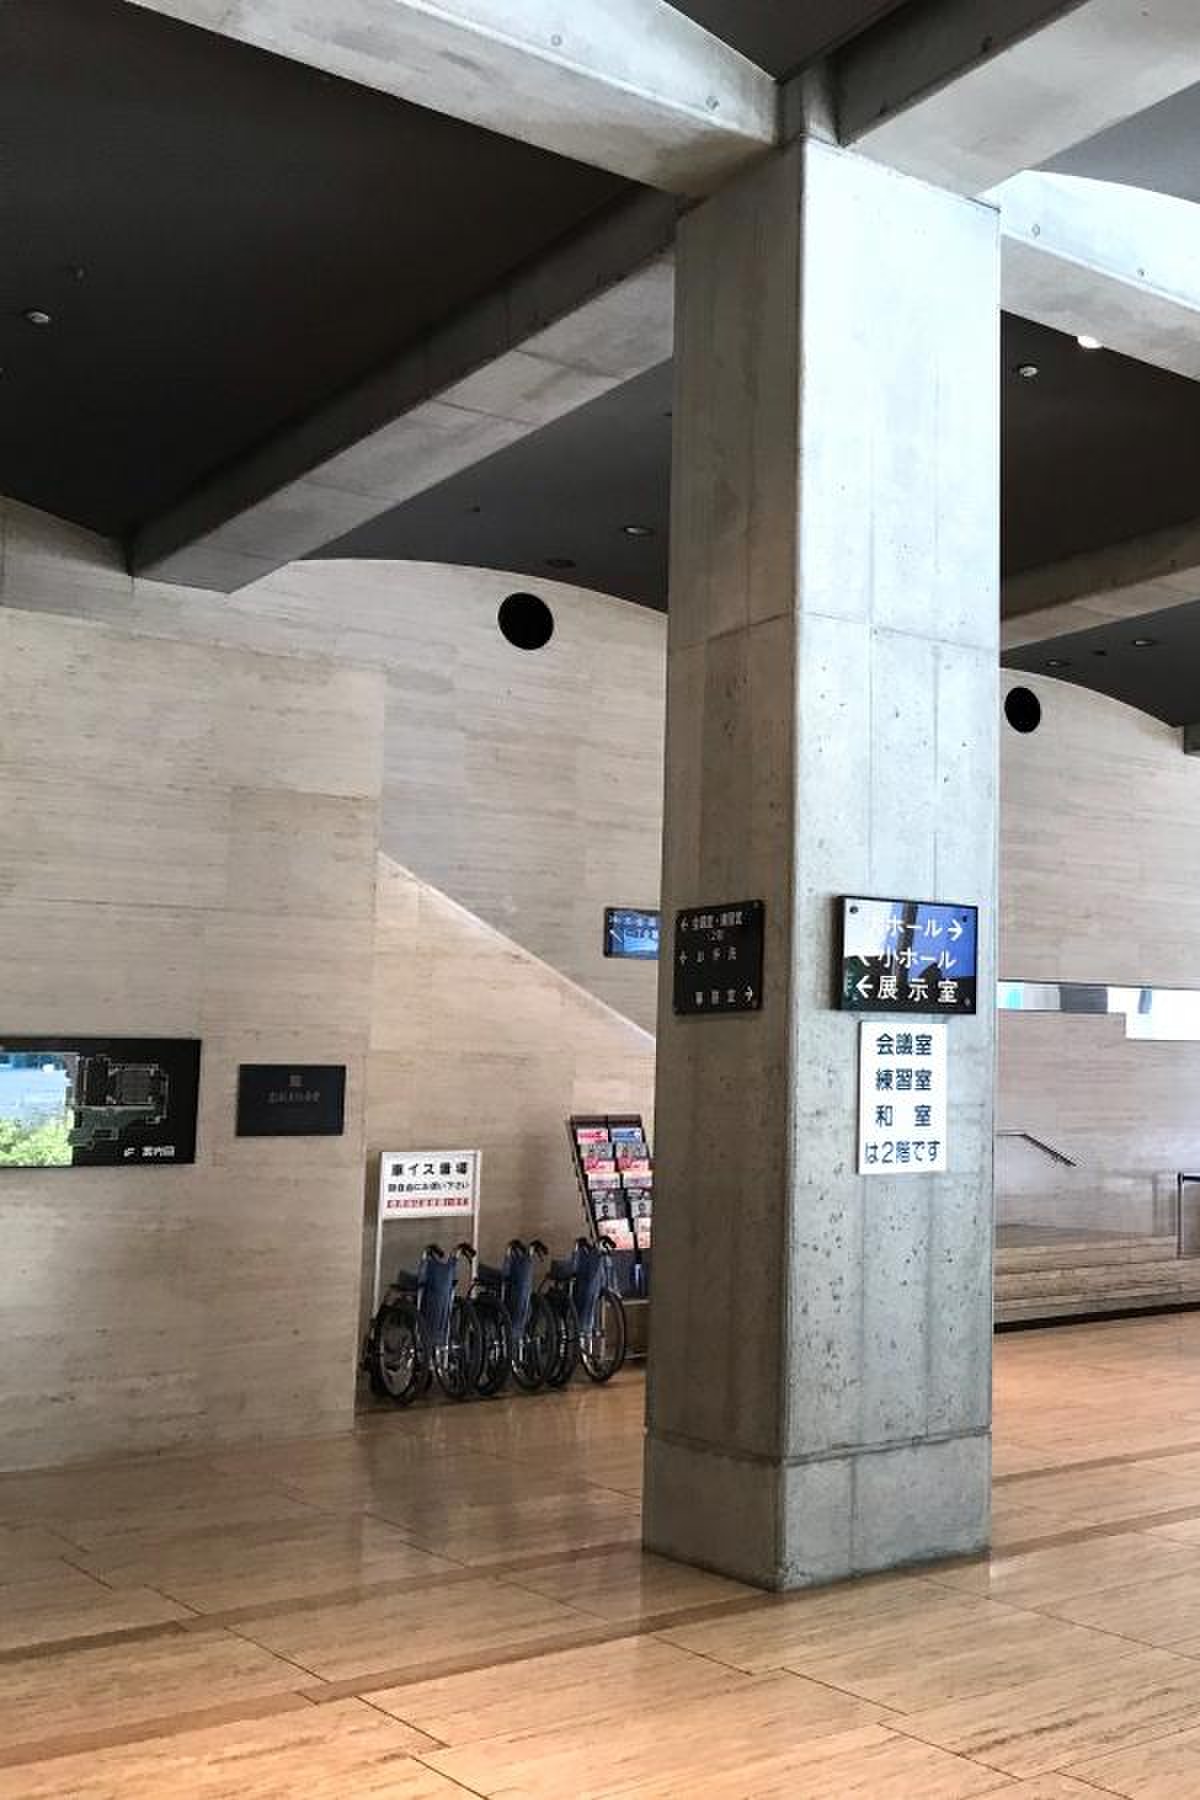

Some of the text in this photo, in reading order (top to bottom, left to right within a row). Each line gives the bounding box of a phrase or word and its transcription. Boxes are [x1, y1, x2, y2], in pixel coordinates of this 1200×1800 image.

[883, 915, 943, 938] ホール
[878, 947, 957, 969] 小ホール
[877, 975, 958, 1004] 展示室
[876, 1033, 933, 1056] 会議室
[876, 1068, 932, 1091] 練習室
[865, 1140, 941, 1164] は2階です
